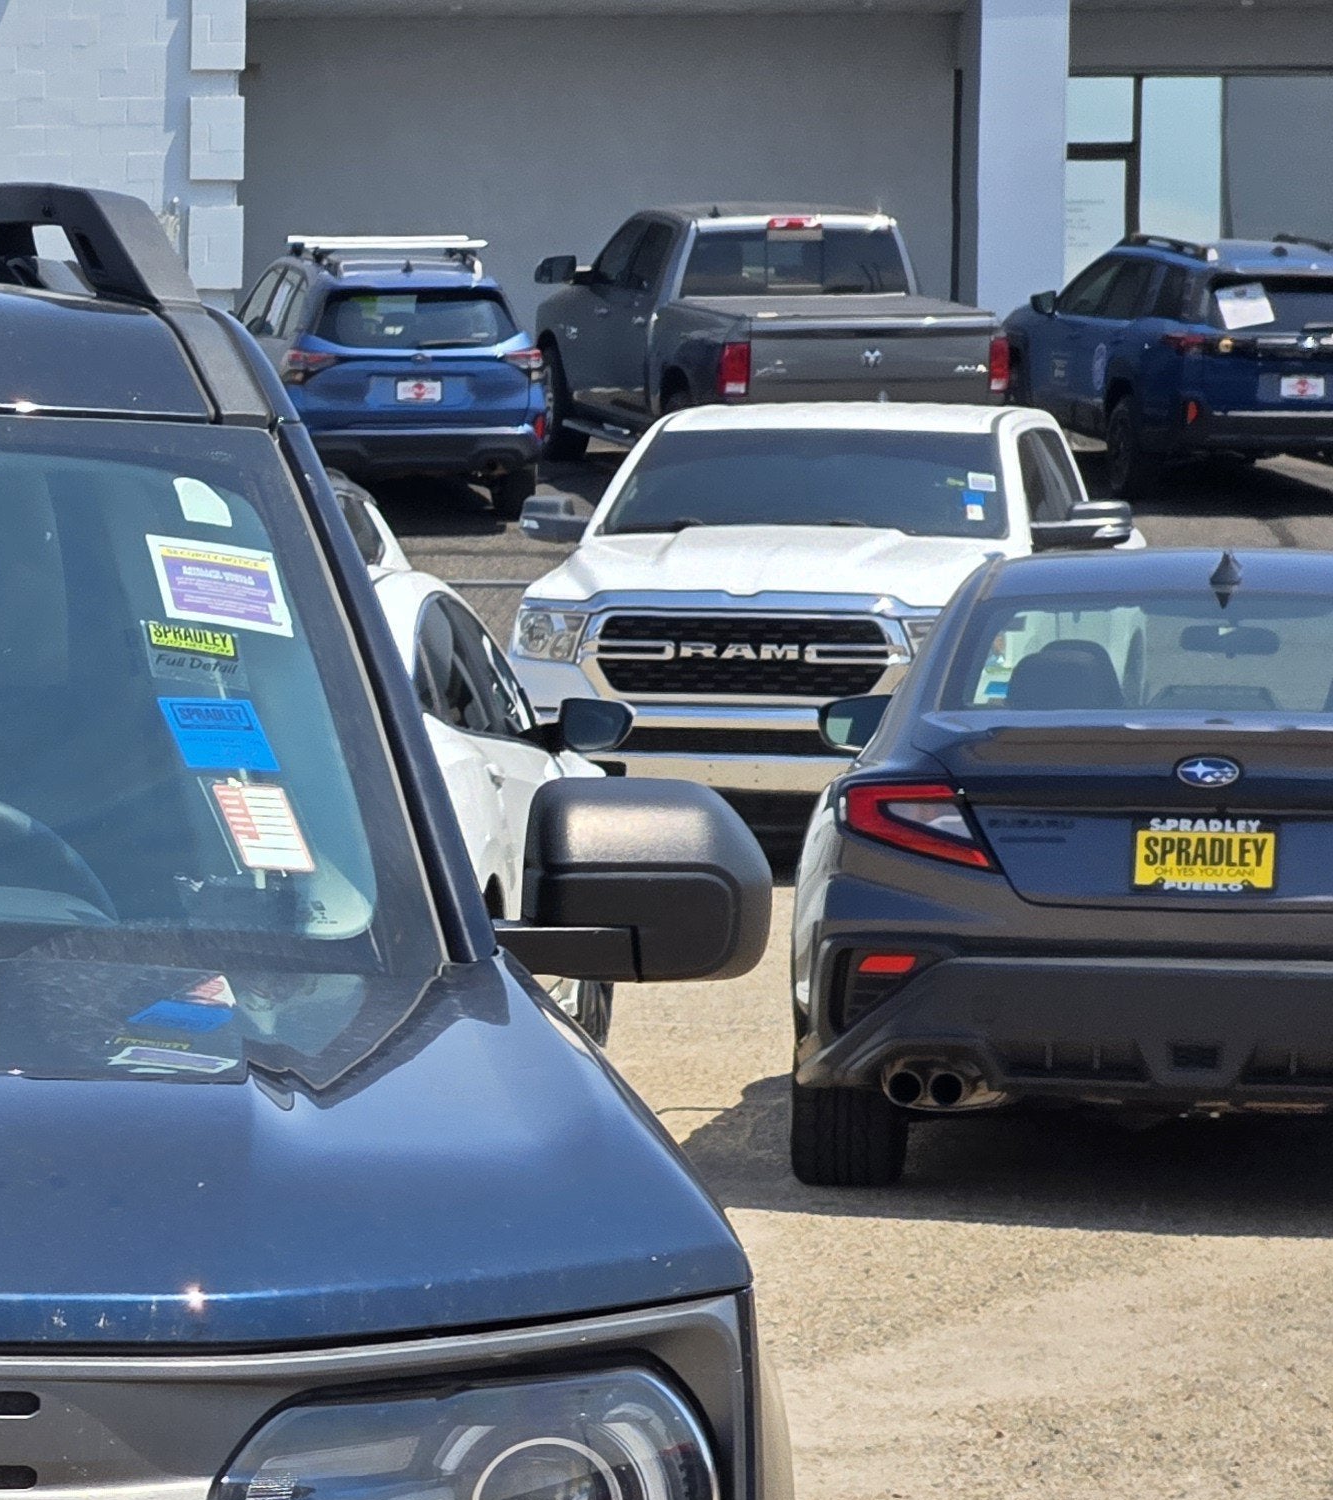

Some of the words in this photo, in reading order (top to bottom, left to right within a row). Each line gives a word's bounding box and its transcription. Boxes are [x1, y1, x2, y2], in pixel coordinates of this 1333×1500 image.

[679, 642, 799, 661] RAM
[155, 653, 186, 667] Full
[189, 657, 238, 675] Detail
[1149, 818, 1261, 833] SPRADLEY
[1144, 836, 1268, 867] SPRADLEY
[1154, 866, 1172, 877] OH
[1175, 867, 1195, 877] YES
[1198, 867, 1224, 877] YOU
[1226, 867, 1255, 878] CAN!
[1163, 882, 1244, 892] PUEBLO
